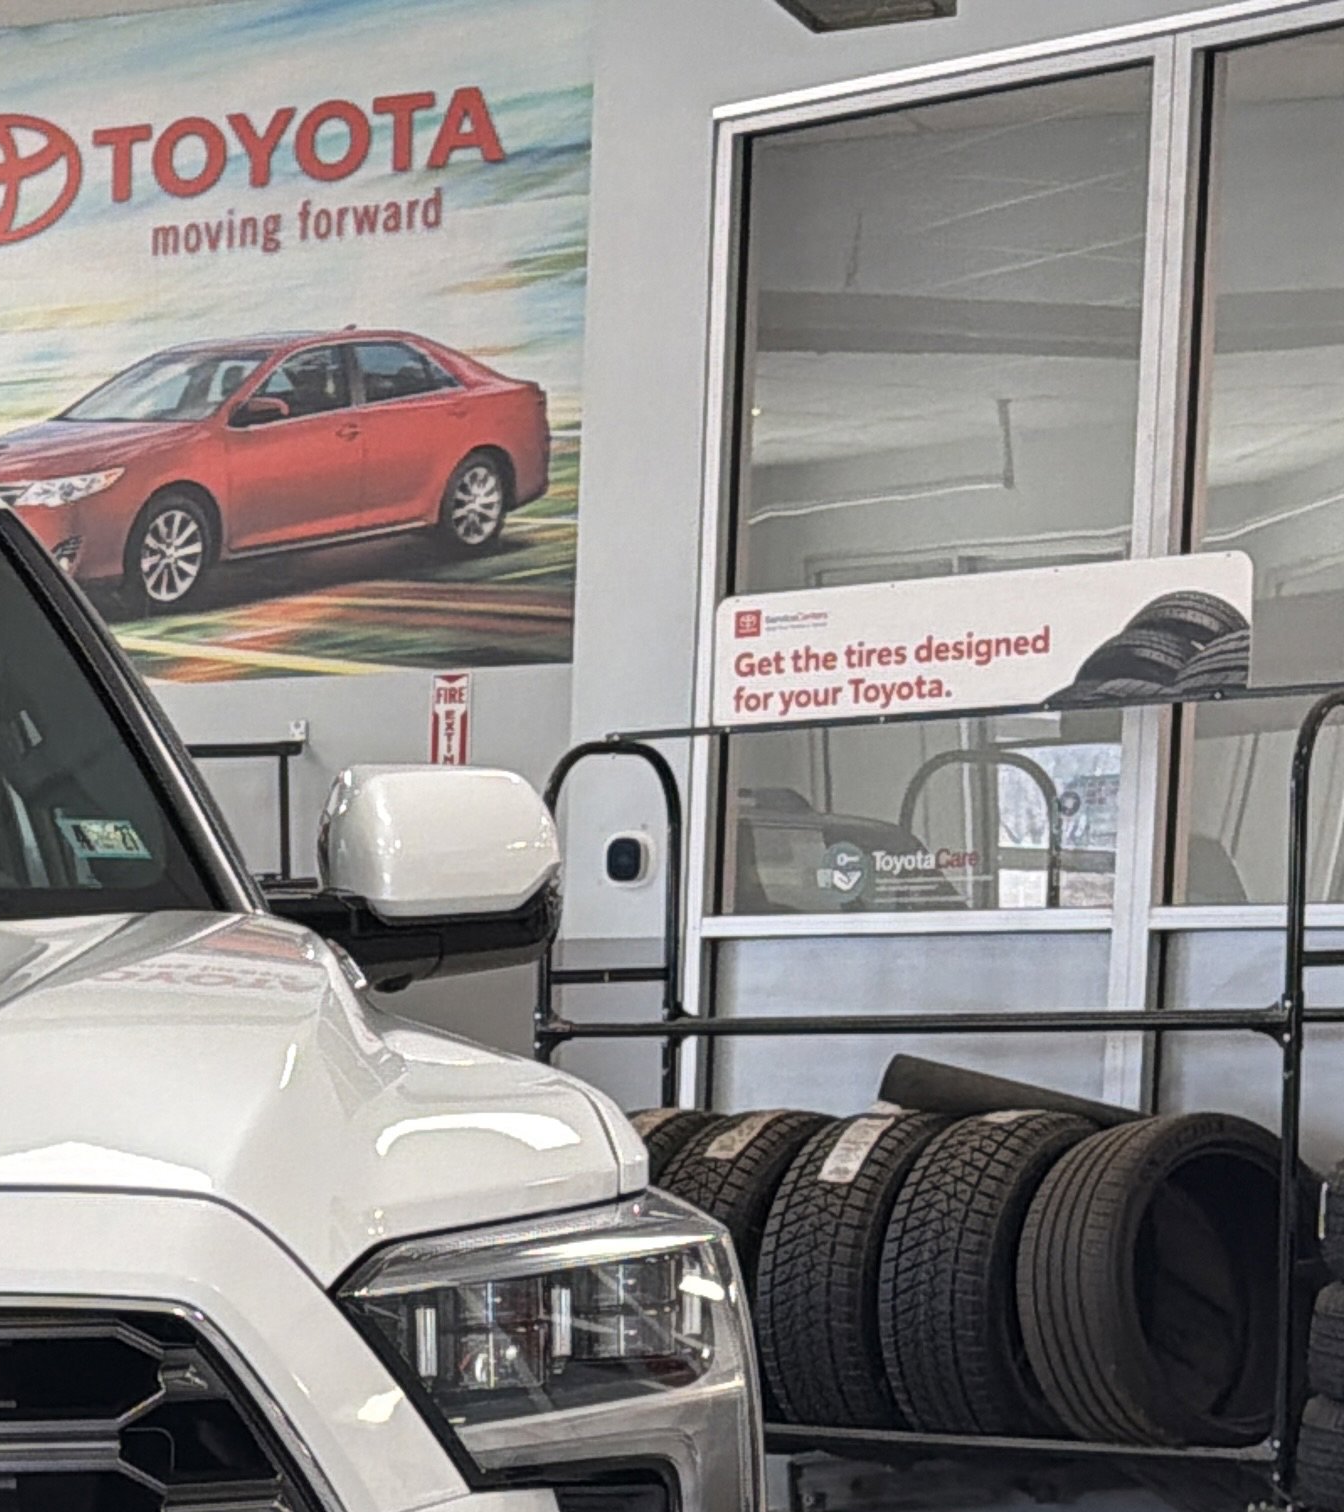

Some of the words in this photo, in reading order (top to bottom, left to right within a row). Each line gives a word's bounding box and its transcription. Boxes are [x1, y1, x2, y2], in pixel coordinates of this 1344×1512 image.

[92, 86, 508, 203] TOYOTA
[152, 208, 282, 256] moving
[298, 187, 443, 242] forward
[734, 650, 785, 677] Get
[791, 645, 838, 672] the
[845, 641, 907, 669] tires
[914, 625, 1051, 667] designed
[435, 686, 466, 704] FIRE
[733, 685, 774, 713] for
[779, 685, 843, 716] your
[848, 675, 953, 709] Toyota.
[872, 847, 980, 875] ToyotaCare
